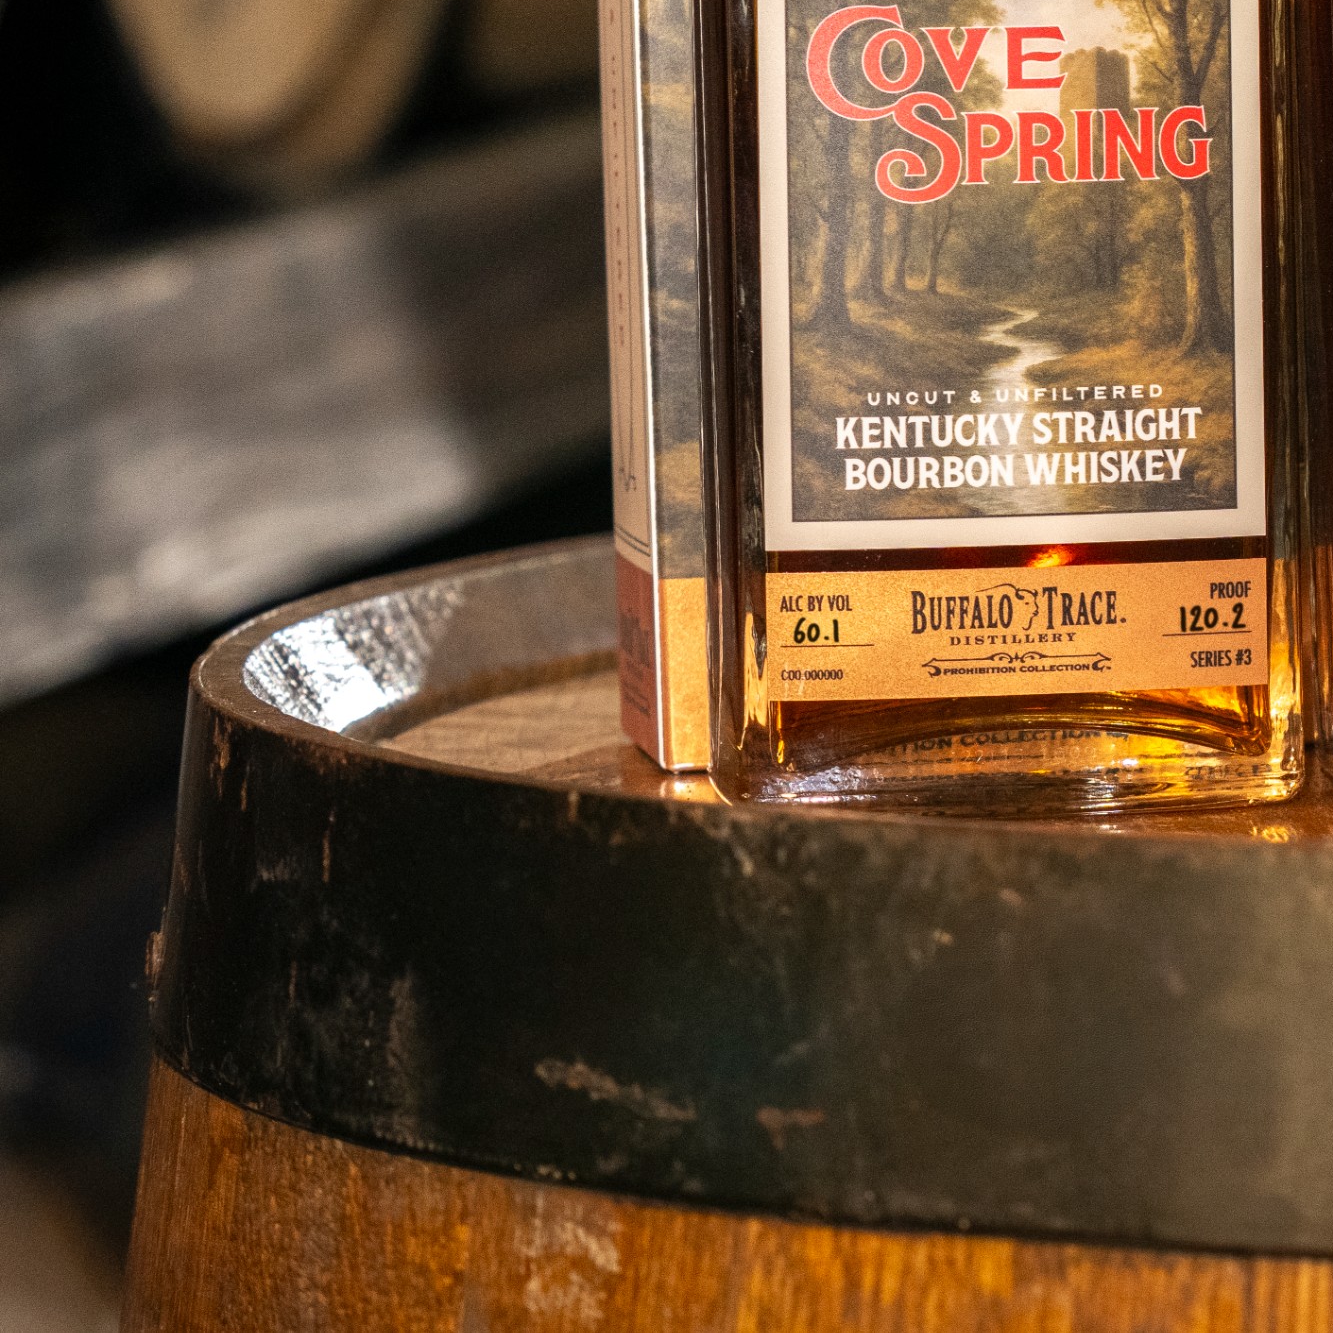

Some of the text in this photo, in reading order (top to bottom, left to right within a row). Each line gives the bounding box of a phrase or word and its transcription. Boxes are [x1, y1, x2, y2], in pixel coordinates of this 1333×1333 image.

[805, 4, 1068, 121] COVE
[875, 90, 1214, 204] SPRING
[867, 384, 1164, 407] UNCUT & UNFILTERED
[834, 406, 1203, 450] KENTUCKY STRAIGHT
[844, 447, 1188, 492] BOURBON WHISKEY
[1210, 581, 1252, 599] PROOF
[780, 595, 853, 613] ALC BY VOL
[911, 591, 1013, 634] BUFFALO
[1179, 602, 1247, 633] 120.2
[793, 617, 840, 644] 60.1
[949, 632, 1077, 646] DISTILLERY
[943, 664, 1090, 675] PROHIBITION COLLECTION
[1190, 649, 1252, 668] SERIES #3
